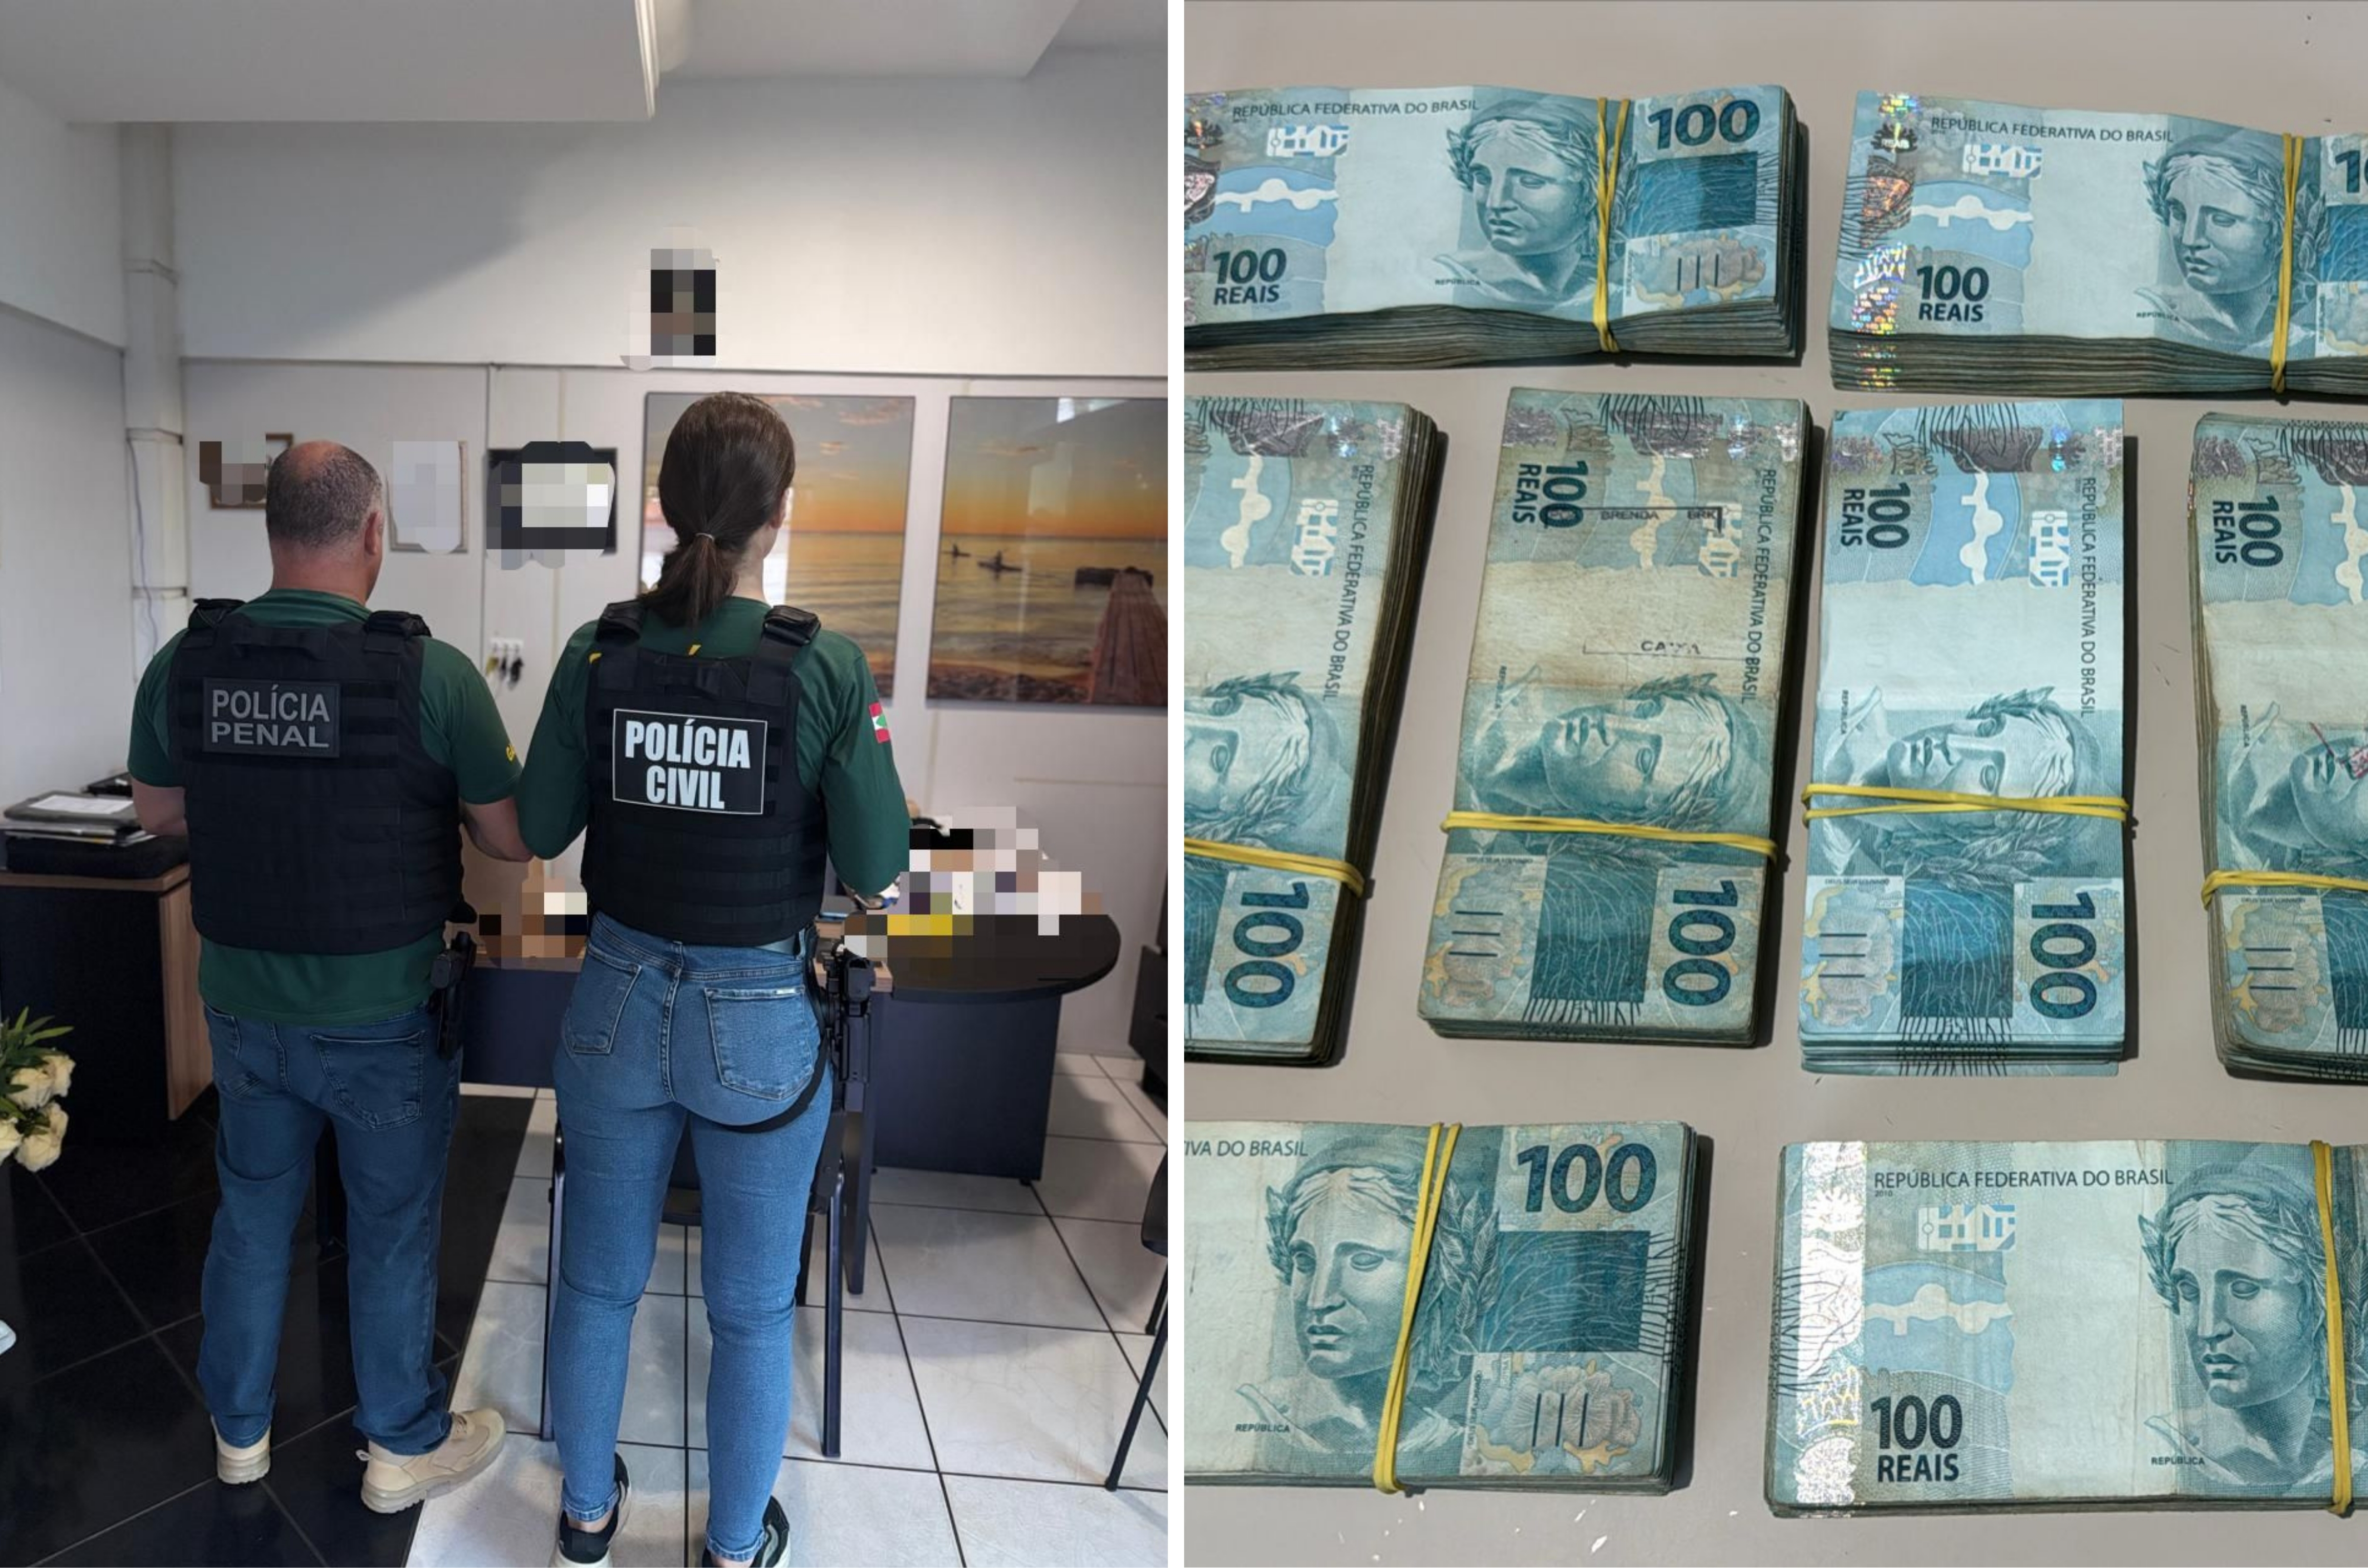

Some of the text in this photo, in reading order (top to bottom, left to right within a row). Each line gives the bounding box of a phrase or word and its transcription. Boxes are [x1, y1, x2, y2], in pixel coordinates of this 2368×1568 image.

[1232, 99, 1479, 117] REPÚBLICA FEDERATIVA DO BRASIL
[1648, 99, 1760, 150] 100
[1931, 116, 2173, 143] REPÚBLICA FEDERATIVA DO BRASIL
[1212, 248, 1287, 285] 100
[1917, 265, 1989, 300] 100
[1213, 285, 1280, 305] REAIS
[1918, 303, 1983, 322] REAIS
[1512, 463, 1542, 524] REAIS
[1539, 460, 1589, 529] 100
[1841, 488, 1865, 547] REAIS
[1866, 482, 1911, 549] 100
[2212, 501, 2237, 564] REAIS
[2237, 496, 2283, 567] 100
[1322, 464, 1374, 701] REPÚBLICA FEDERATIVA DO BRASIL
[1741, 469, 1776, 703] REPÚBLICA FEDERATIVA DO BRASIL
[2081, 477, 2096, 717] REPÚBLICA FEDERATIVA DO BRASIL
[212, 684, 330, 722] POLÍCIA
[211, 722, 329, 748] PENAL
[625, 718, 751, 769] POLÍCIA
[646, 765, 725, 810] CIVIL
[1224, 881, 1309, 1008] 100
[1663, 880, 1739, 1006] 100
[2030, 892, 2097, 1020] 100
[1184, 1140, 1309, 1157] IVA DO BRASIL
[1517, 1143, 1657, 1213] 100
[1874, 1169, 2174, 1189] REPÚBLICA FEDERATIVA DO BRASIL
[1870, 1394, 1963, 1450] 100
[1877, 1453, 1960, 1483] REAIS
